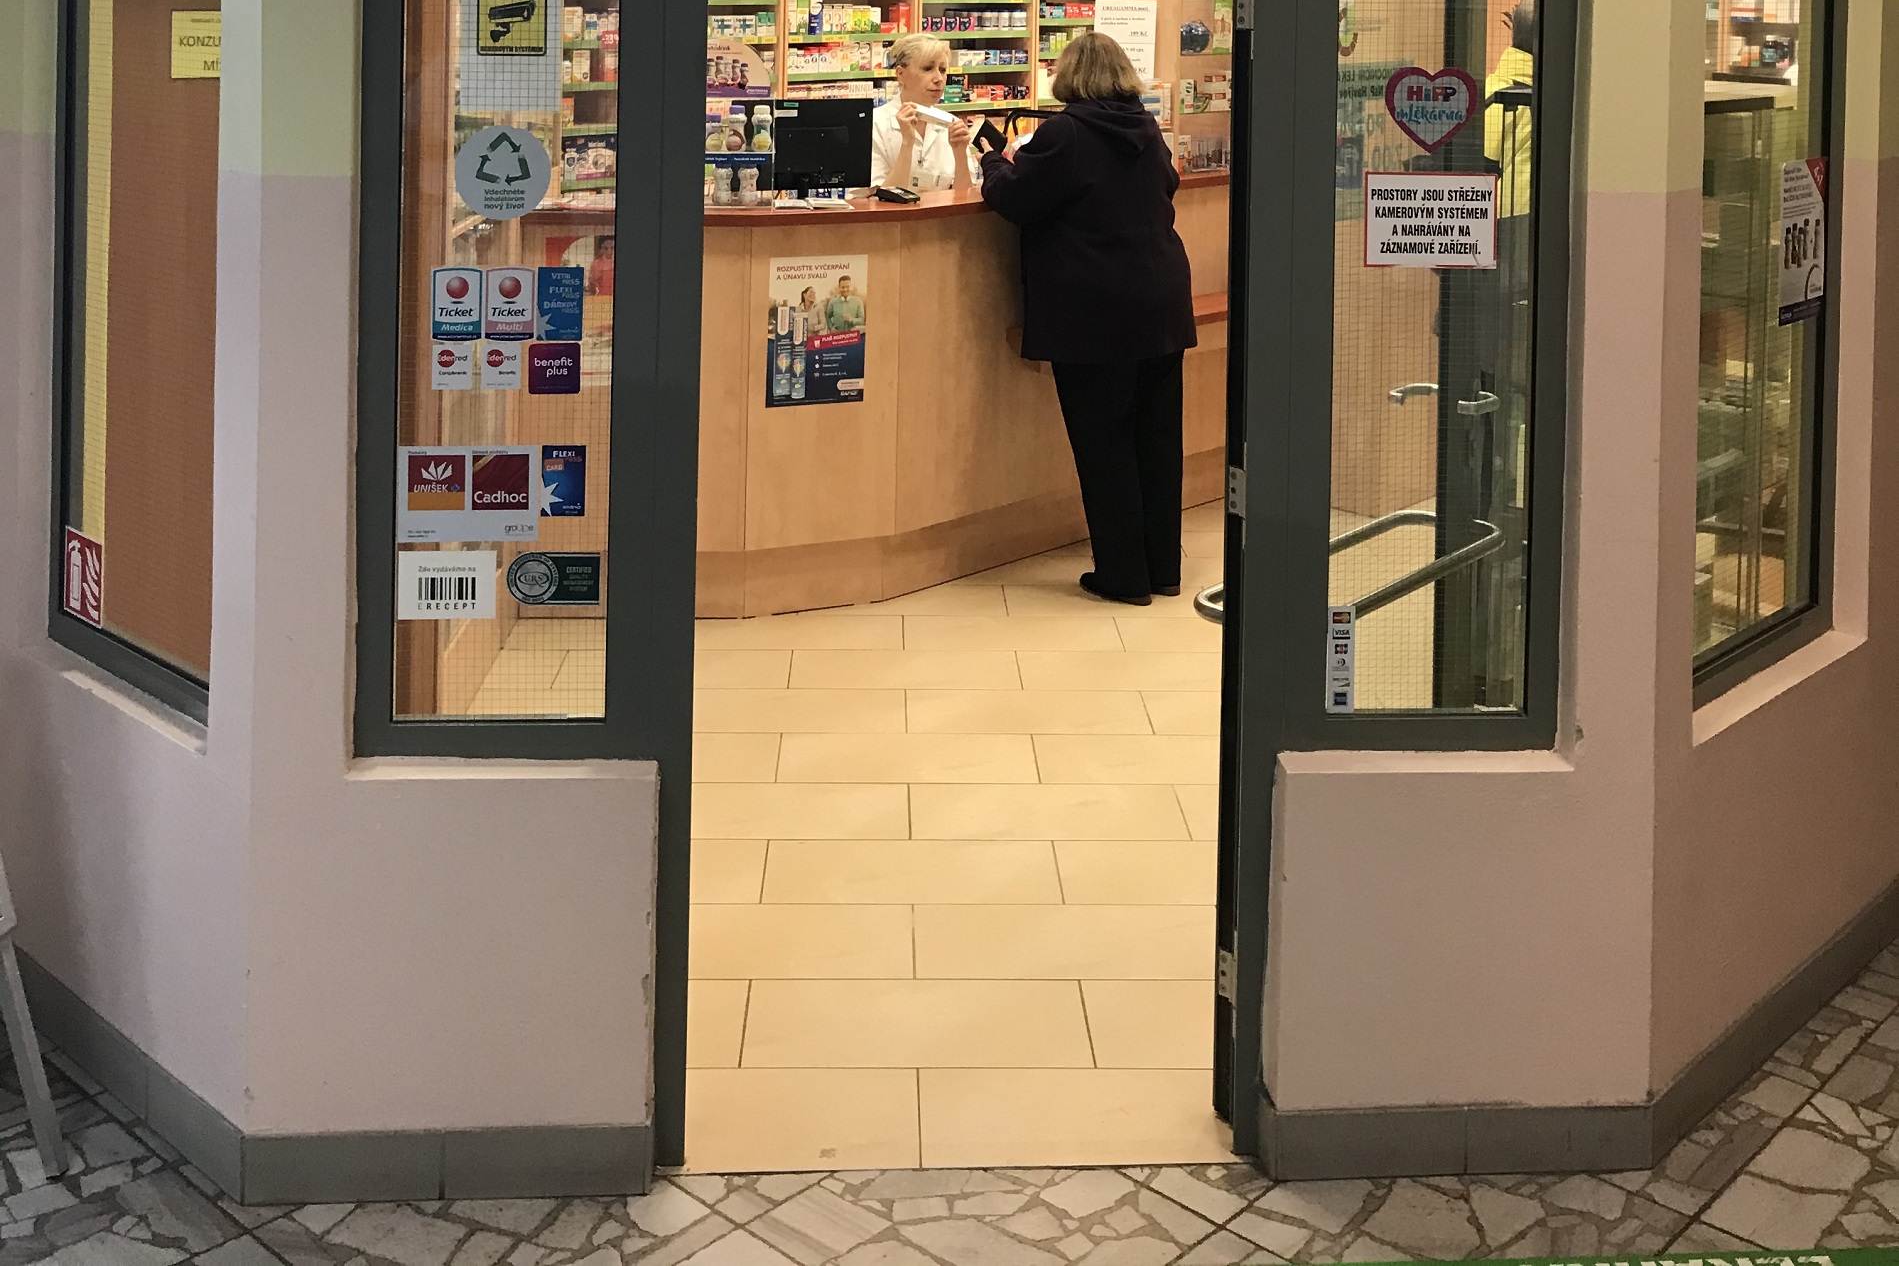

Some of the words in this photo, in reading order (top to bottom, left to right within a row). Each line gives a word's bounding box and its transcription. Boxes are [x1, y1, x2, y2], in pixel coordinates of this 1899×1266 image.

[1407, 86, 1457, 102] HiPP
[1371, 188, 1418, 202] PROSTORY
[1421, 188, 1444, 202] JSOU
[1447, 186, 1493, 202] STŘEŽENY
[484, 202, 503, 210] nový
[1375, 204, 1434, 219] KAMEROVÝM
[1437, 204, 1488, 220] SYSTÉMEM
[1392, 224, 1398, 236] A
[1401, 222, 1455, 237] NAHRÁVÁNY
[1458, 225, 1471, 237] NA
[1380, 241, 1435, 255] ZÁZNAMOVÉ
[1438, 240, 1481, 255] ZAŘÍZENÍ.
[814, 262, 850, 270] VYČERPÁNÍ
[438, 307, 474, 317] Ticket
[491, 307, 526, 317] Ticket
[496, 323, 524, 331] Multi
[438, 354, 468, 362] Edenred
[534, 356, 573, 366] benefit
[546, 366, 568, 378] plus
[552, 450, 575, 458] FLEXI
[413, 482, 449, 493] UNIŠEK
[474, 491, 527, 503] Cadhoc
[432, 565, 466, 573] vydáváme
[524, 575, 544, 587] URS
